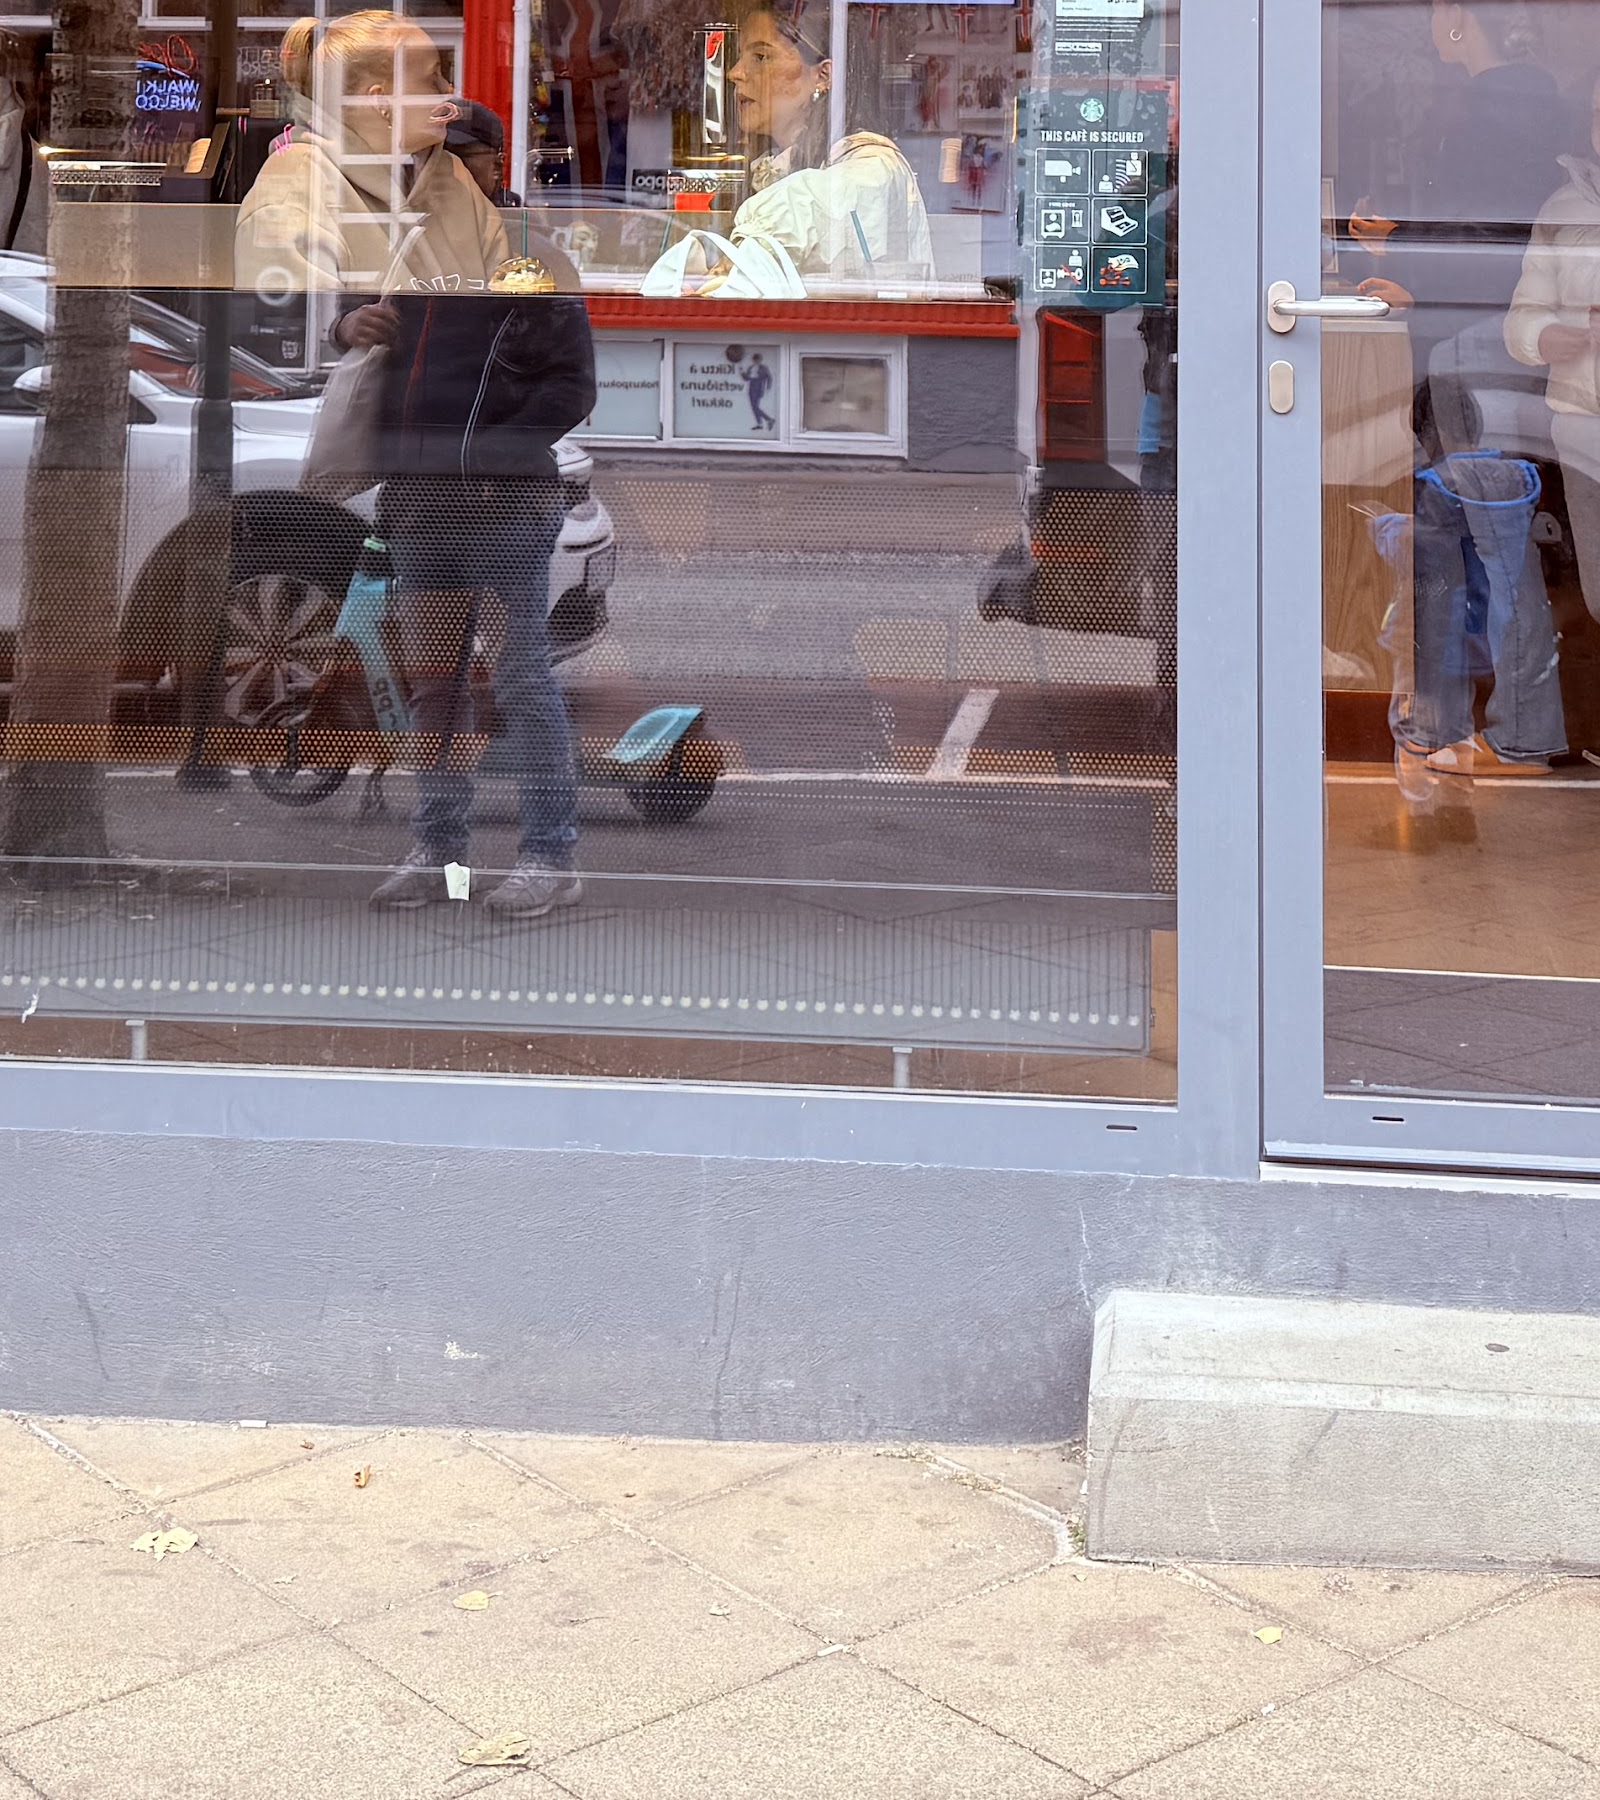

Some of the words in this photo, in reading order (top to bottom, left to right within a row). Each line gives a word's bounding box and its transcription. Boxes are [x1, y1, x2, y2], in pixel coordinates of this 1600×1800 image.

[1041, 131, 1062, 142] THIS
[1089, 131, 1099, 142] IS
[1100, 131, 1144, 143] SECURED
